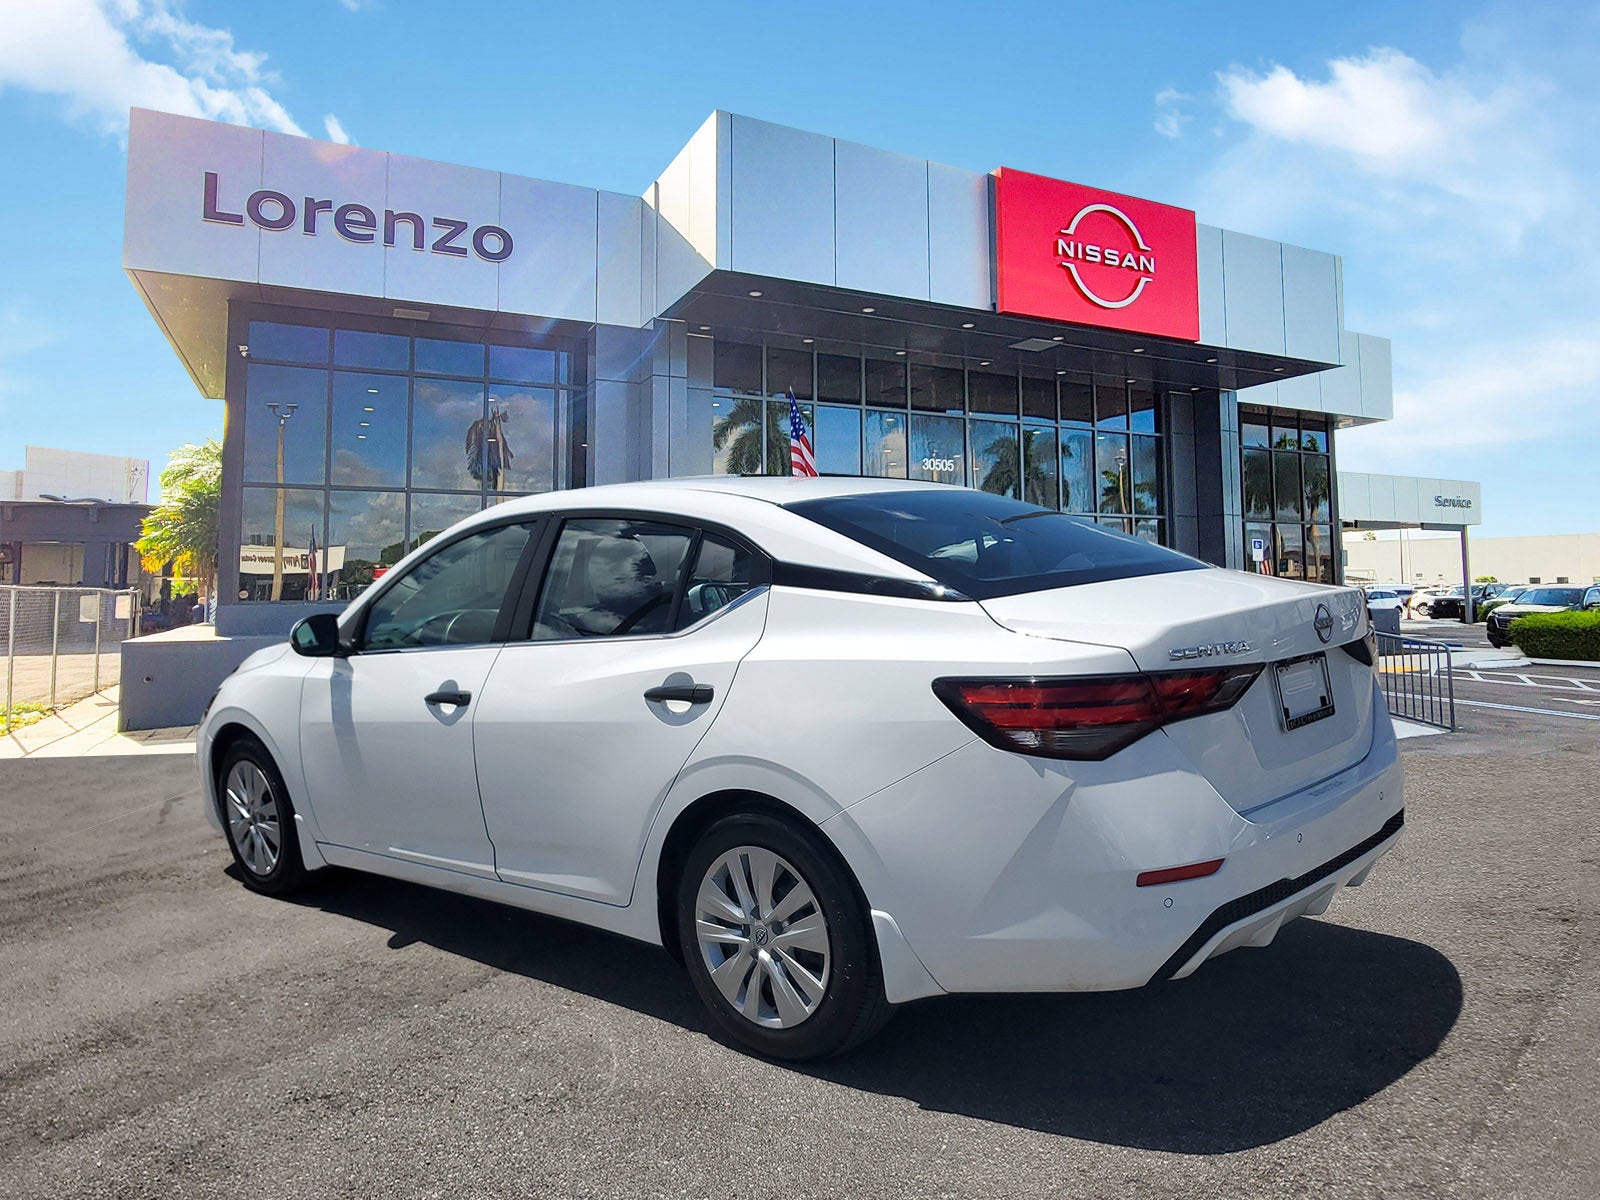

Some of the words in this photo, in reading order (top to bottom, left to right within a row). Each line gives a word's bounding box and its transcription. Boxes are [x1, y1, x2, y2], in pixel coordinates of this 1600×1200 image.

[202, 171, 514, 263] Lorenzo
[1057, 238, 1155, 273] NISSAN
[922, 458, 954, 472] 30505
[1434, 495, 1472, 508] Service
[1168, 640, 1250, 661] SENTRA
